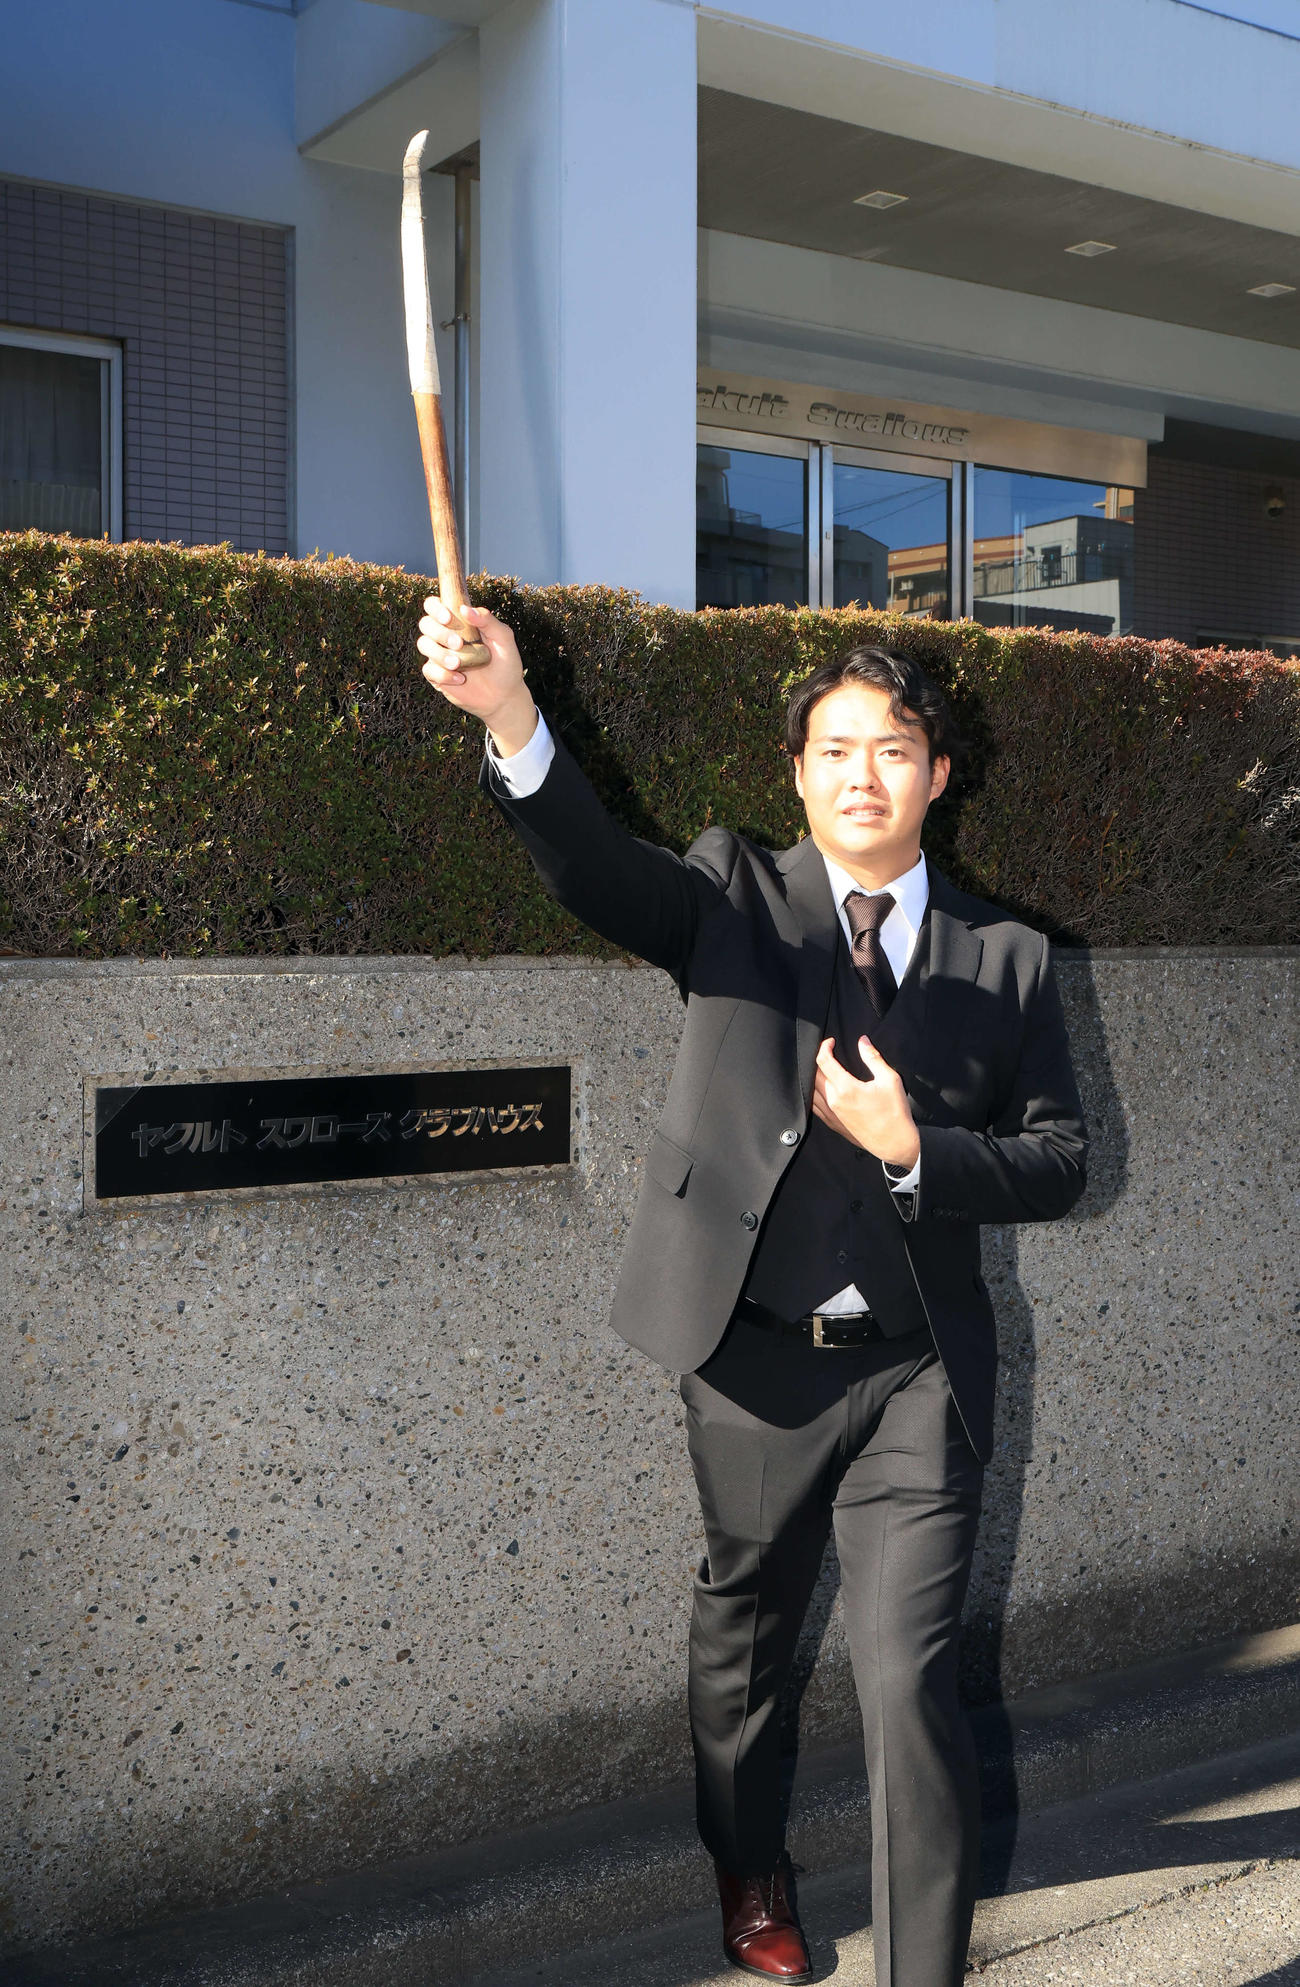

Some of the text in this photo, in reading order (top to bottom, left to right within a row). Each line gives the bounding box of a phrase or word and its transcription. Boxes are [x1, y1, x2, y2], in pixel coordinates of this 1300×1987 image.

[696, 383, 970, 447] akult Swallows
[131, 1102, 545, 1158] ヤクルト スワローズ クラブハウス
